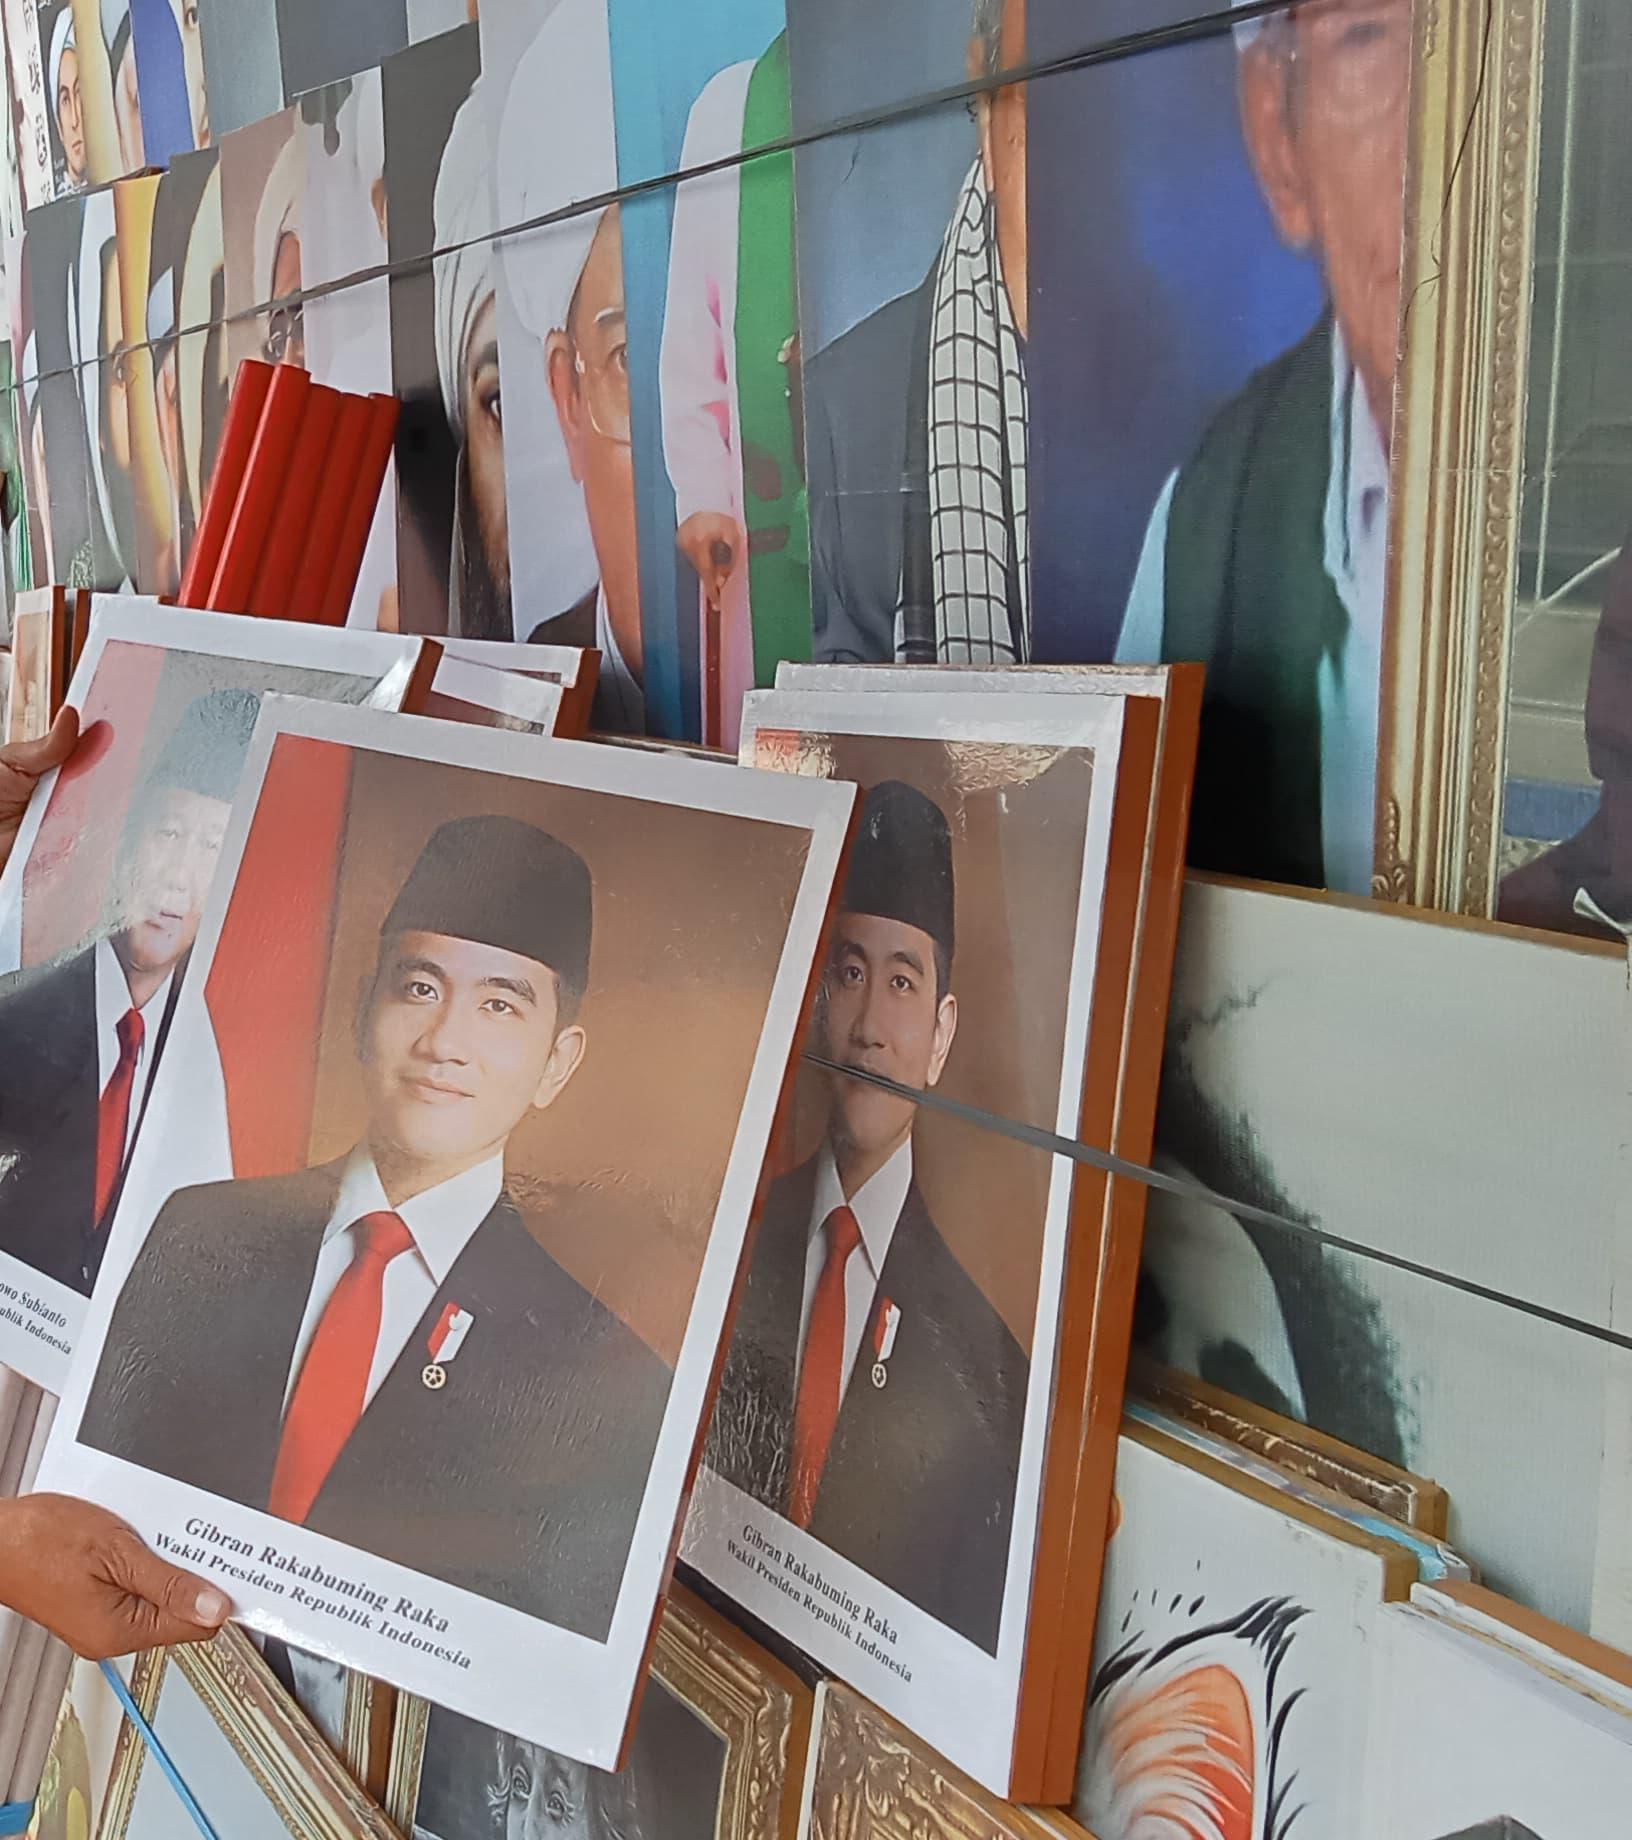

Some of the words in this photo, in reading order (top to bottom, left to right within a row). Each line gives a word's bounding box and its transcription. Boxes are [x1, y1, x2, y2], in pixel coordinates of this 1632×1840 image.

[18, 1291, 67, 1328] Subianto
[24, 1320, 72, 1355] Indonesia
[155, 1531, 206, 1564] Wakil
[207, 1554, 285, 1595] Presiden
[289, 1586, 373, 1630] Republik
[377, 1620, 472, 1670] Indonesia
[185, 1518, 255, 1557] Gibran
[258, 1546, 389, 1613] Rakabuming
[392, 1596, 450, 1633] Raka
[727, 1539, 755, 1569] Wakil
[756, 1561, 800, 1602] Presiden
[803, 1594, 853, 1639] Republik
[855, 1631, 913, 1683] Indonesia
[742, 1524, 782, 1562] Gibran
[784, 1551, 861, 1621] Rakabuming
[863, 1607, 899, 1644] Raka
